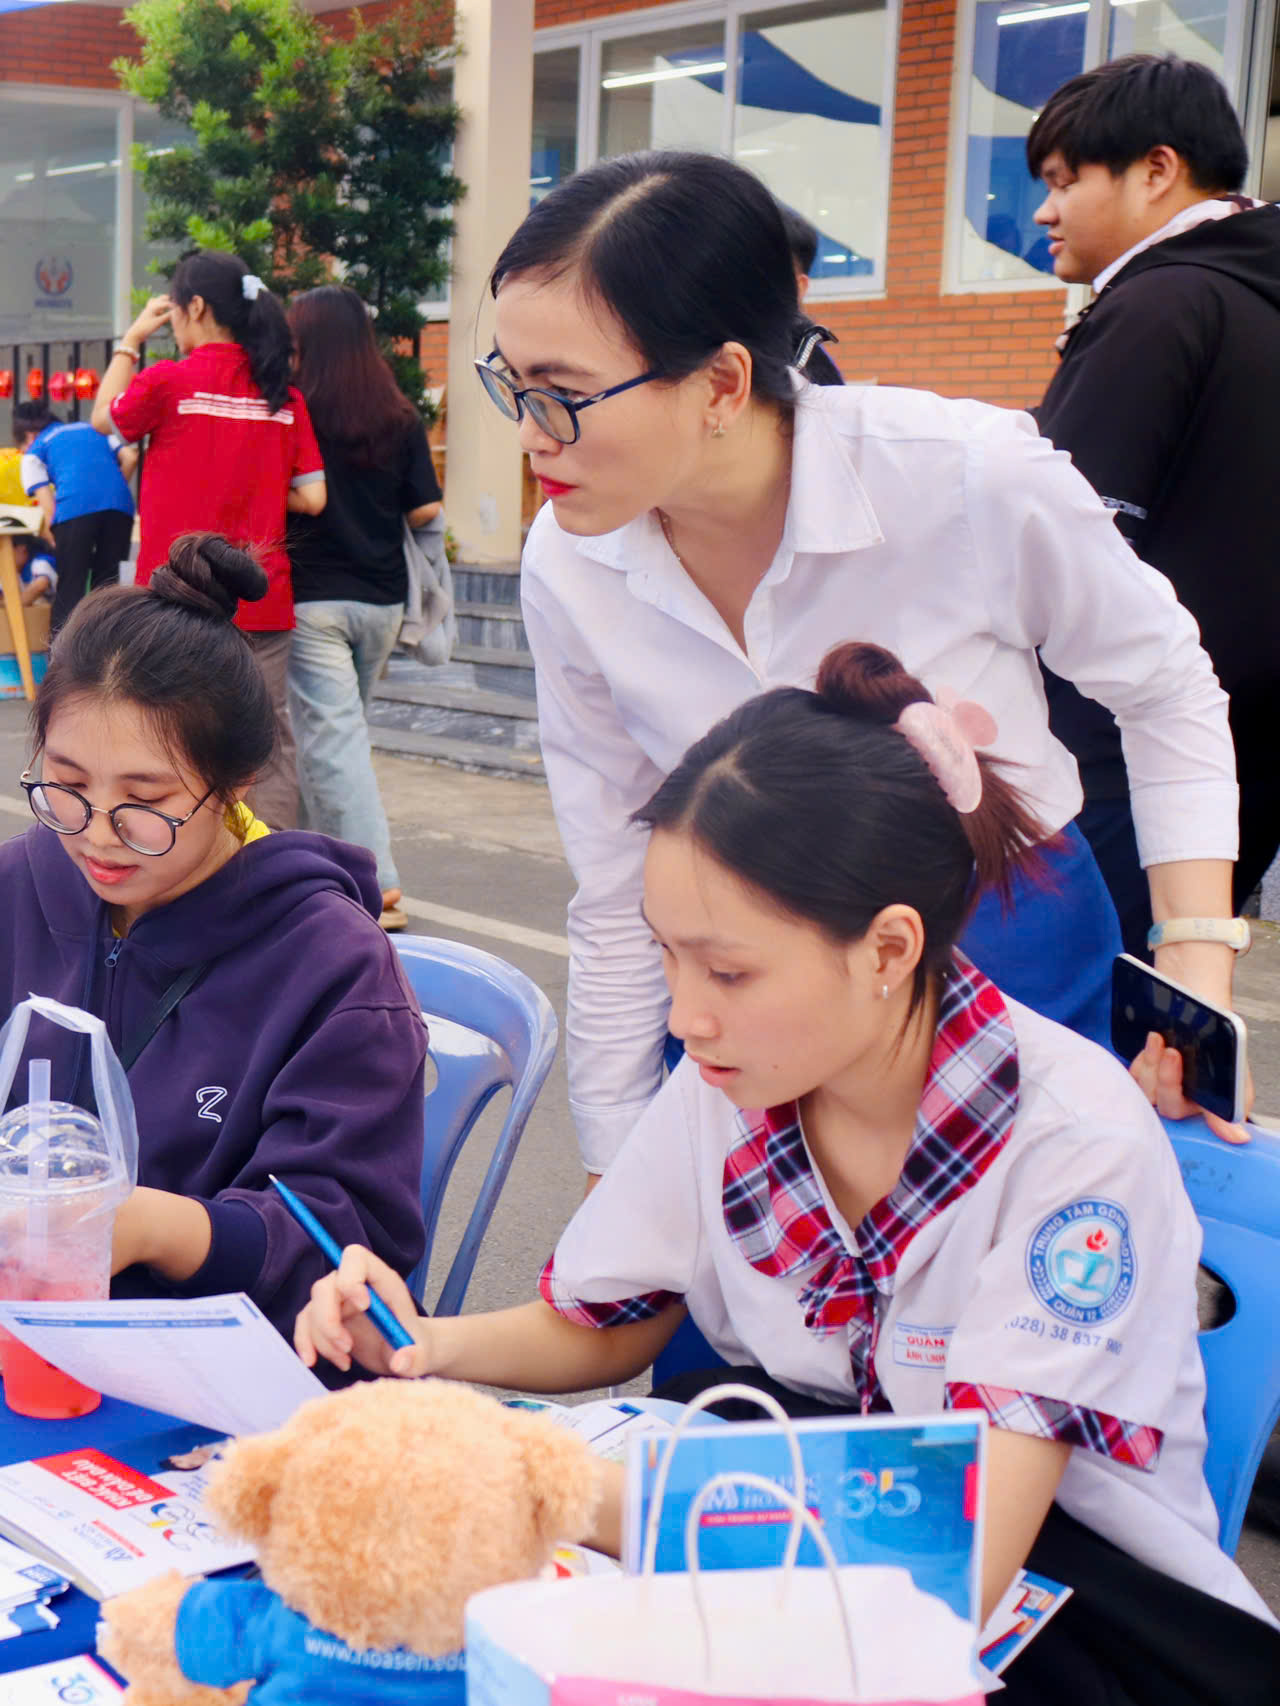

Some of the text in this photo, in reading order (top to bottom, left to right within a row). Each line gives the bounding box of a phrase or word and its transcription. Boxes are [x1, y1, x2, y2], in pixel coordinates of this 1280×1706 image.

[1034, 1216, 1064, 1257] TRUNG
[1050, 1324, 1069, 1341] 38
[836, 1464, 923, 1519] 35
